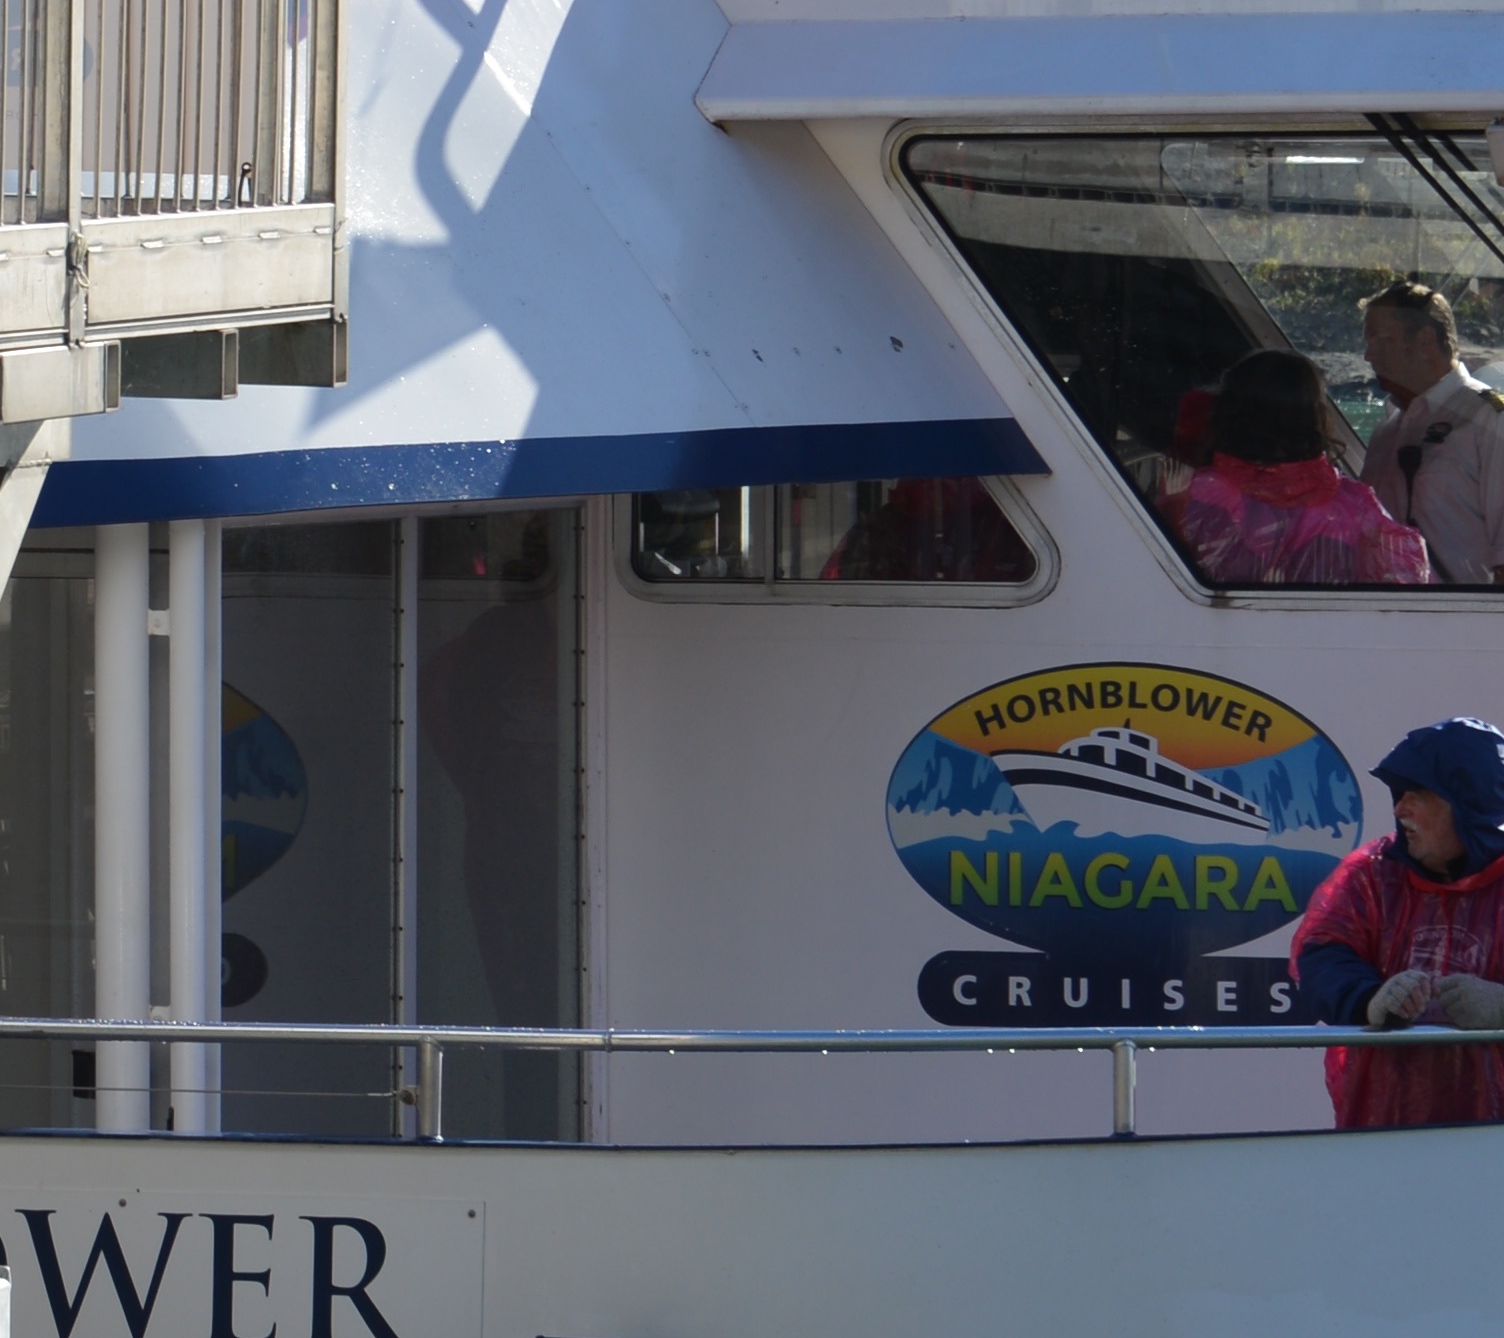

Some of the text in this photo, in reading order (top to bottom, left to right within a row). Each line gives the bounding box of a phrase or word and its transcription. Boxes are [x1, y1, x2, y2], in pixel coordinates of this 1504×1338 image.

[974, 679, 1274, 743] HORNBLOWER
[948, 849, 1299, 913] NIAGARA
[952, 974, 1294, 1014] CRUISES
